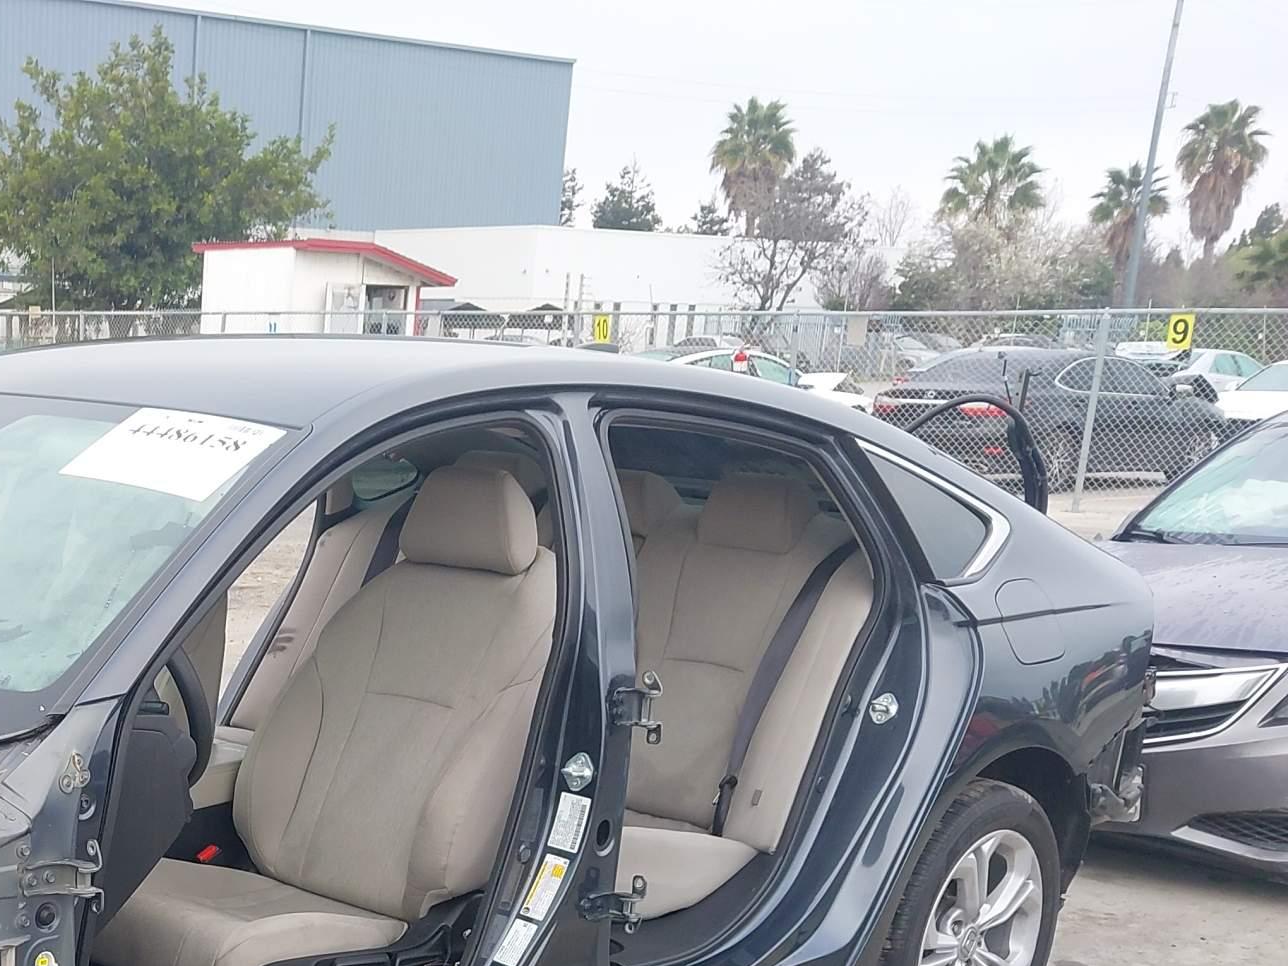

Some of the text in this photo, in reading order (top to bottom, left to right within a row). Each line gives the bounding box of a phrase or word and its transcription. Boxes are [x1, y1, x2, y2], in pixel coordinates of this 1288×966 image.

[597, 319, 608, 340] 10
[1172, 319, 1189, 344] 9
[129, 425, 247, 451] 44486158
